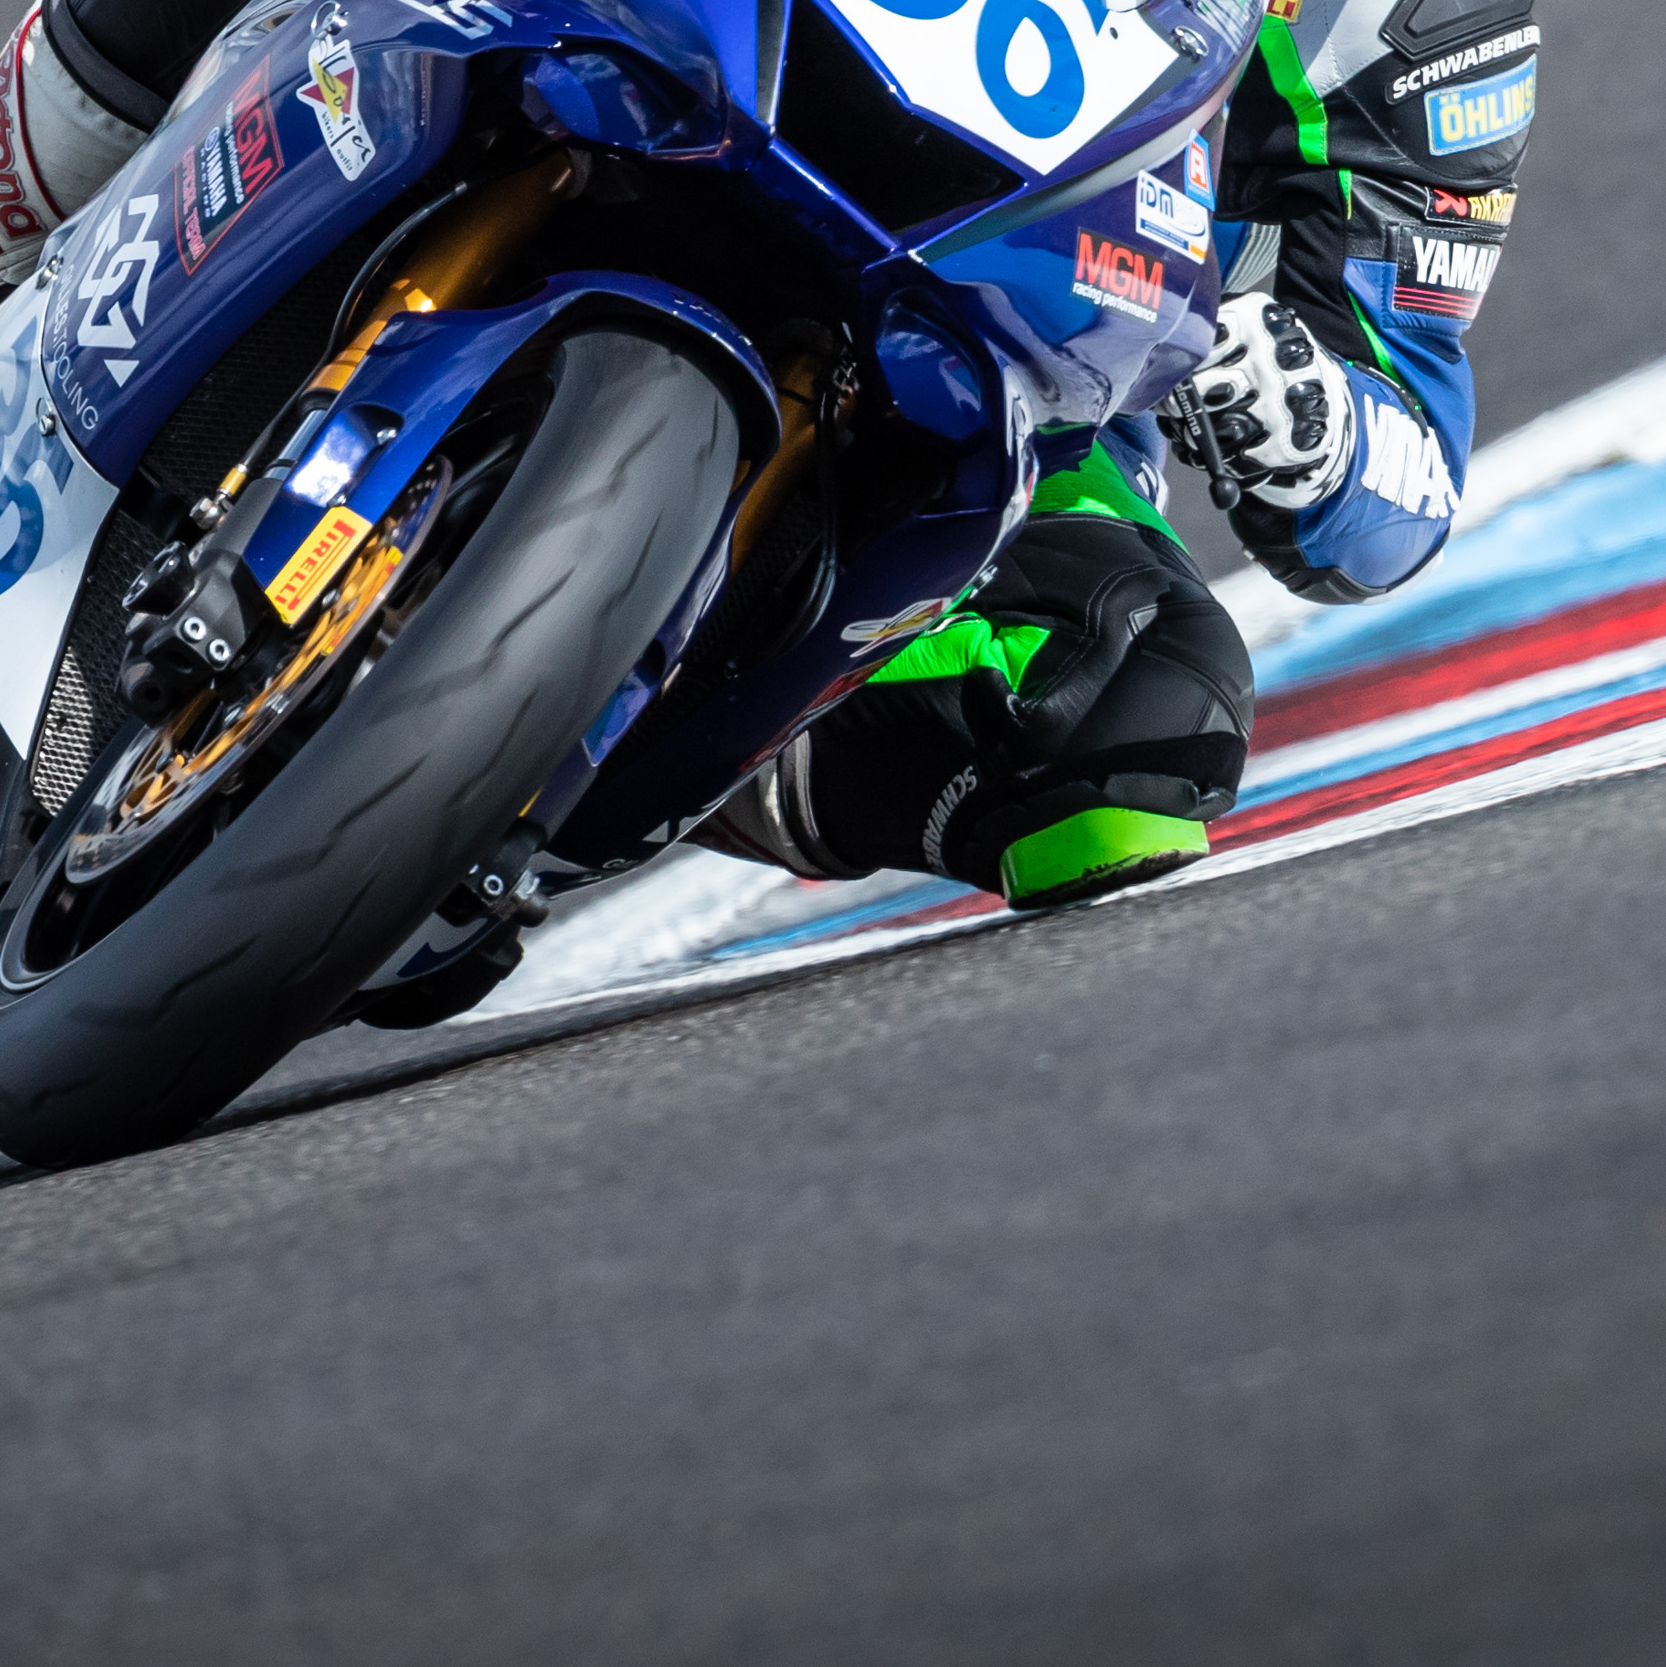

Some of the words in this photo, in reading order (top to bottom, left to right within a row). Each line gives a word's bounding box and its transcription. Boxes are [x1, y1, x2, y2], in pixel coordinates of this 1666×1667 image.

[1074, 233, 1164, 310] MGM
[1071, 281, 1101, 306] racing
[1100, 291, 1158, 324] performance
